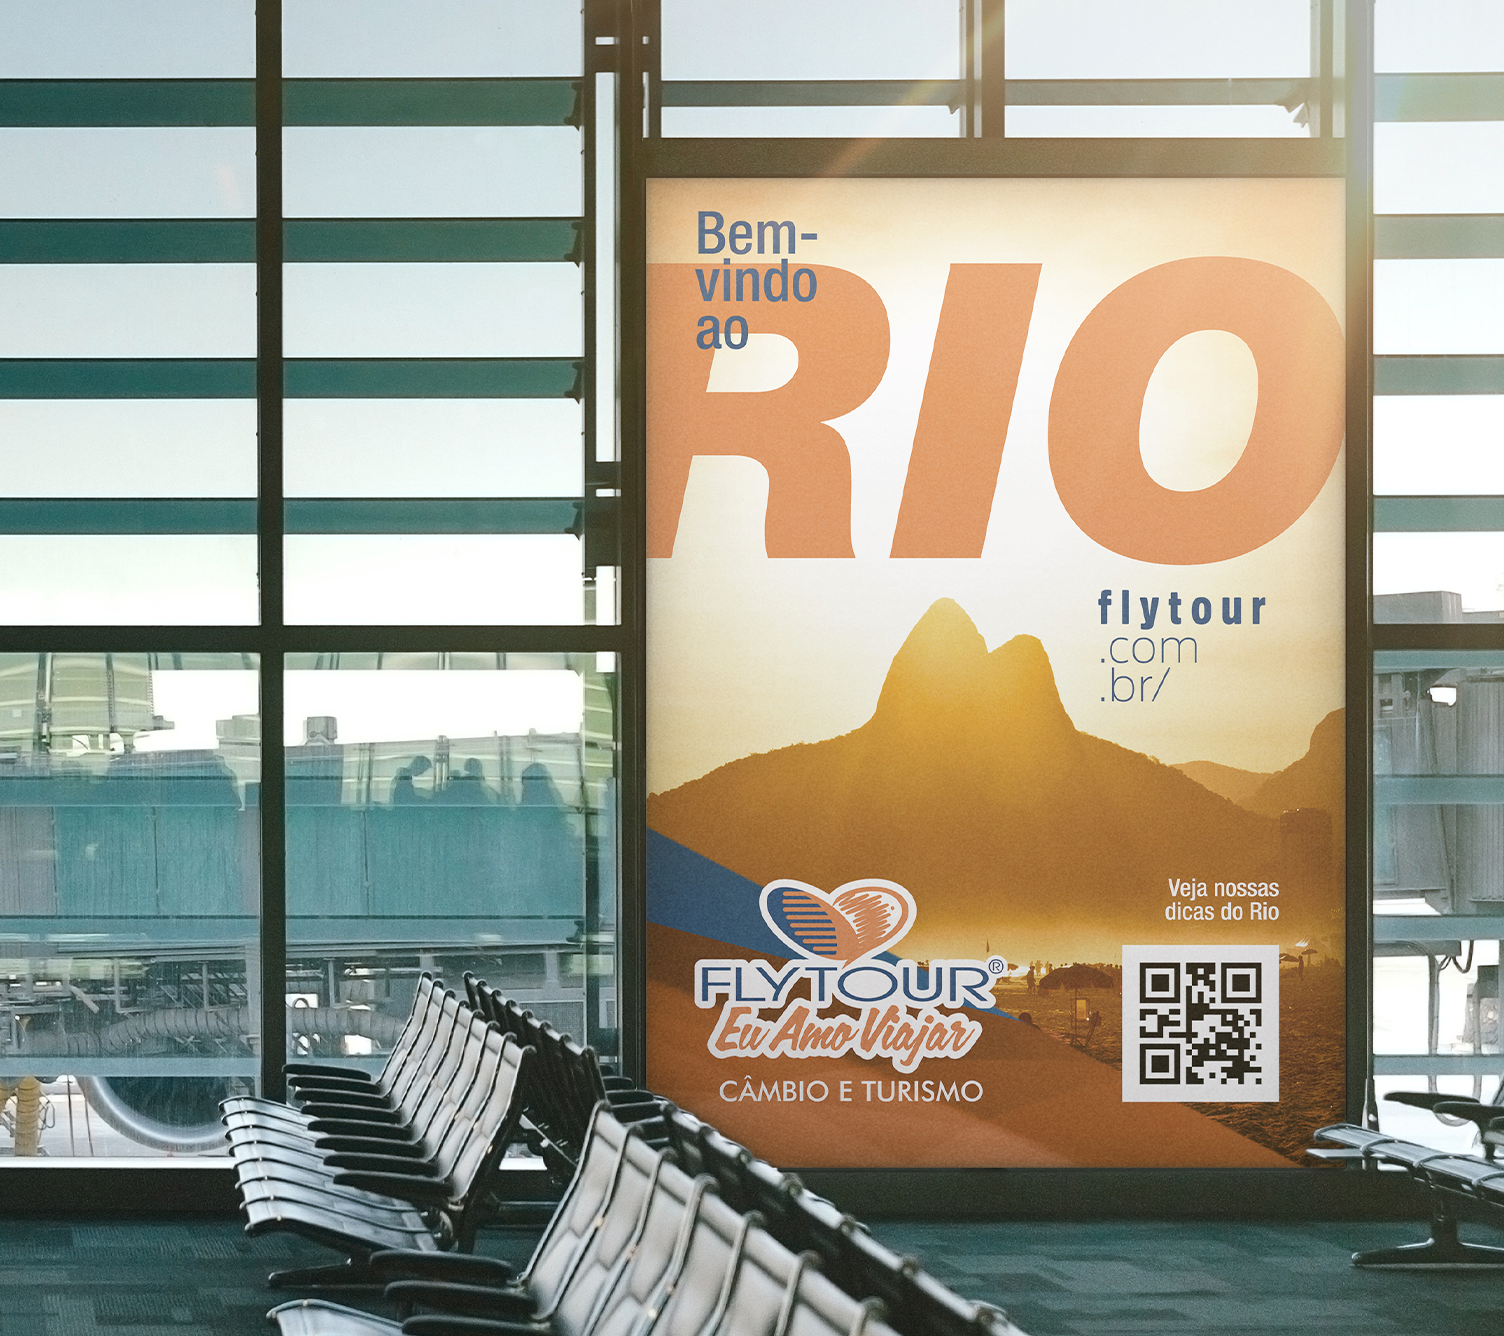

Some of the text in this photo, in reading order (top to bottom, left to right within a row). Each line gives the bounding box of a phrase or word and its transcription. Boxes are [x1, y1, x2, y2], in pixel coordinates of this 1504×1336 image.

[697, 211, 818, 255] Bem-
[695, 259, 818, 302] vindo
[695, 314, 749, 350] ao
[647, 255, 1345, 565] RIO
[1098, 589, 1266, 630] flytour
[1100, 635, 1198, 664] .com
[1168, 878, 1279, 901] Veja nossas
[1165, 902, 1279, 920] dicas do Rio
[715, 1005, 975, 1066] Eu Amo Viajar
[719, 1075, 983, 1102] CÂMBIO E TURISMO
